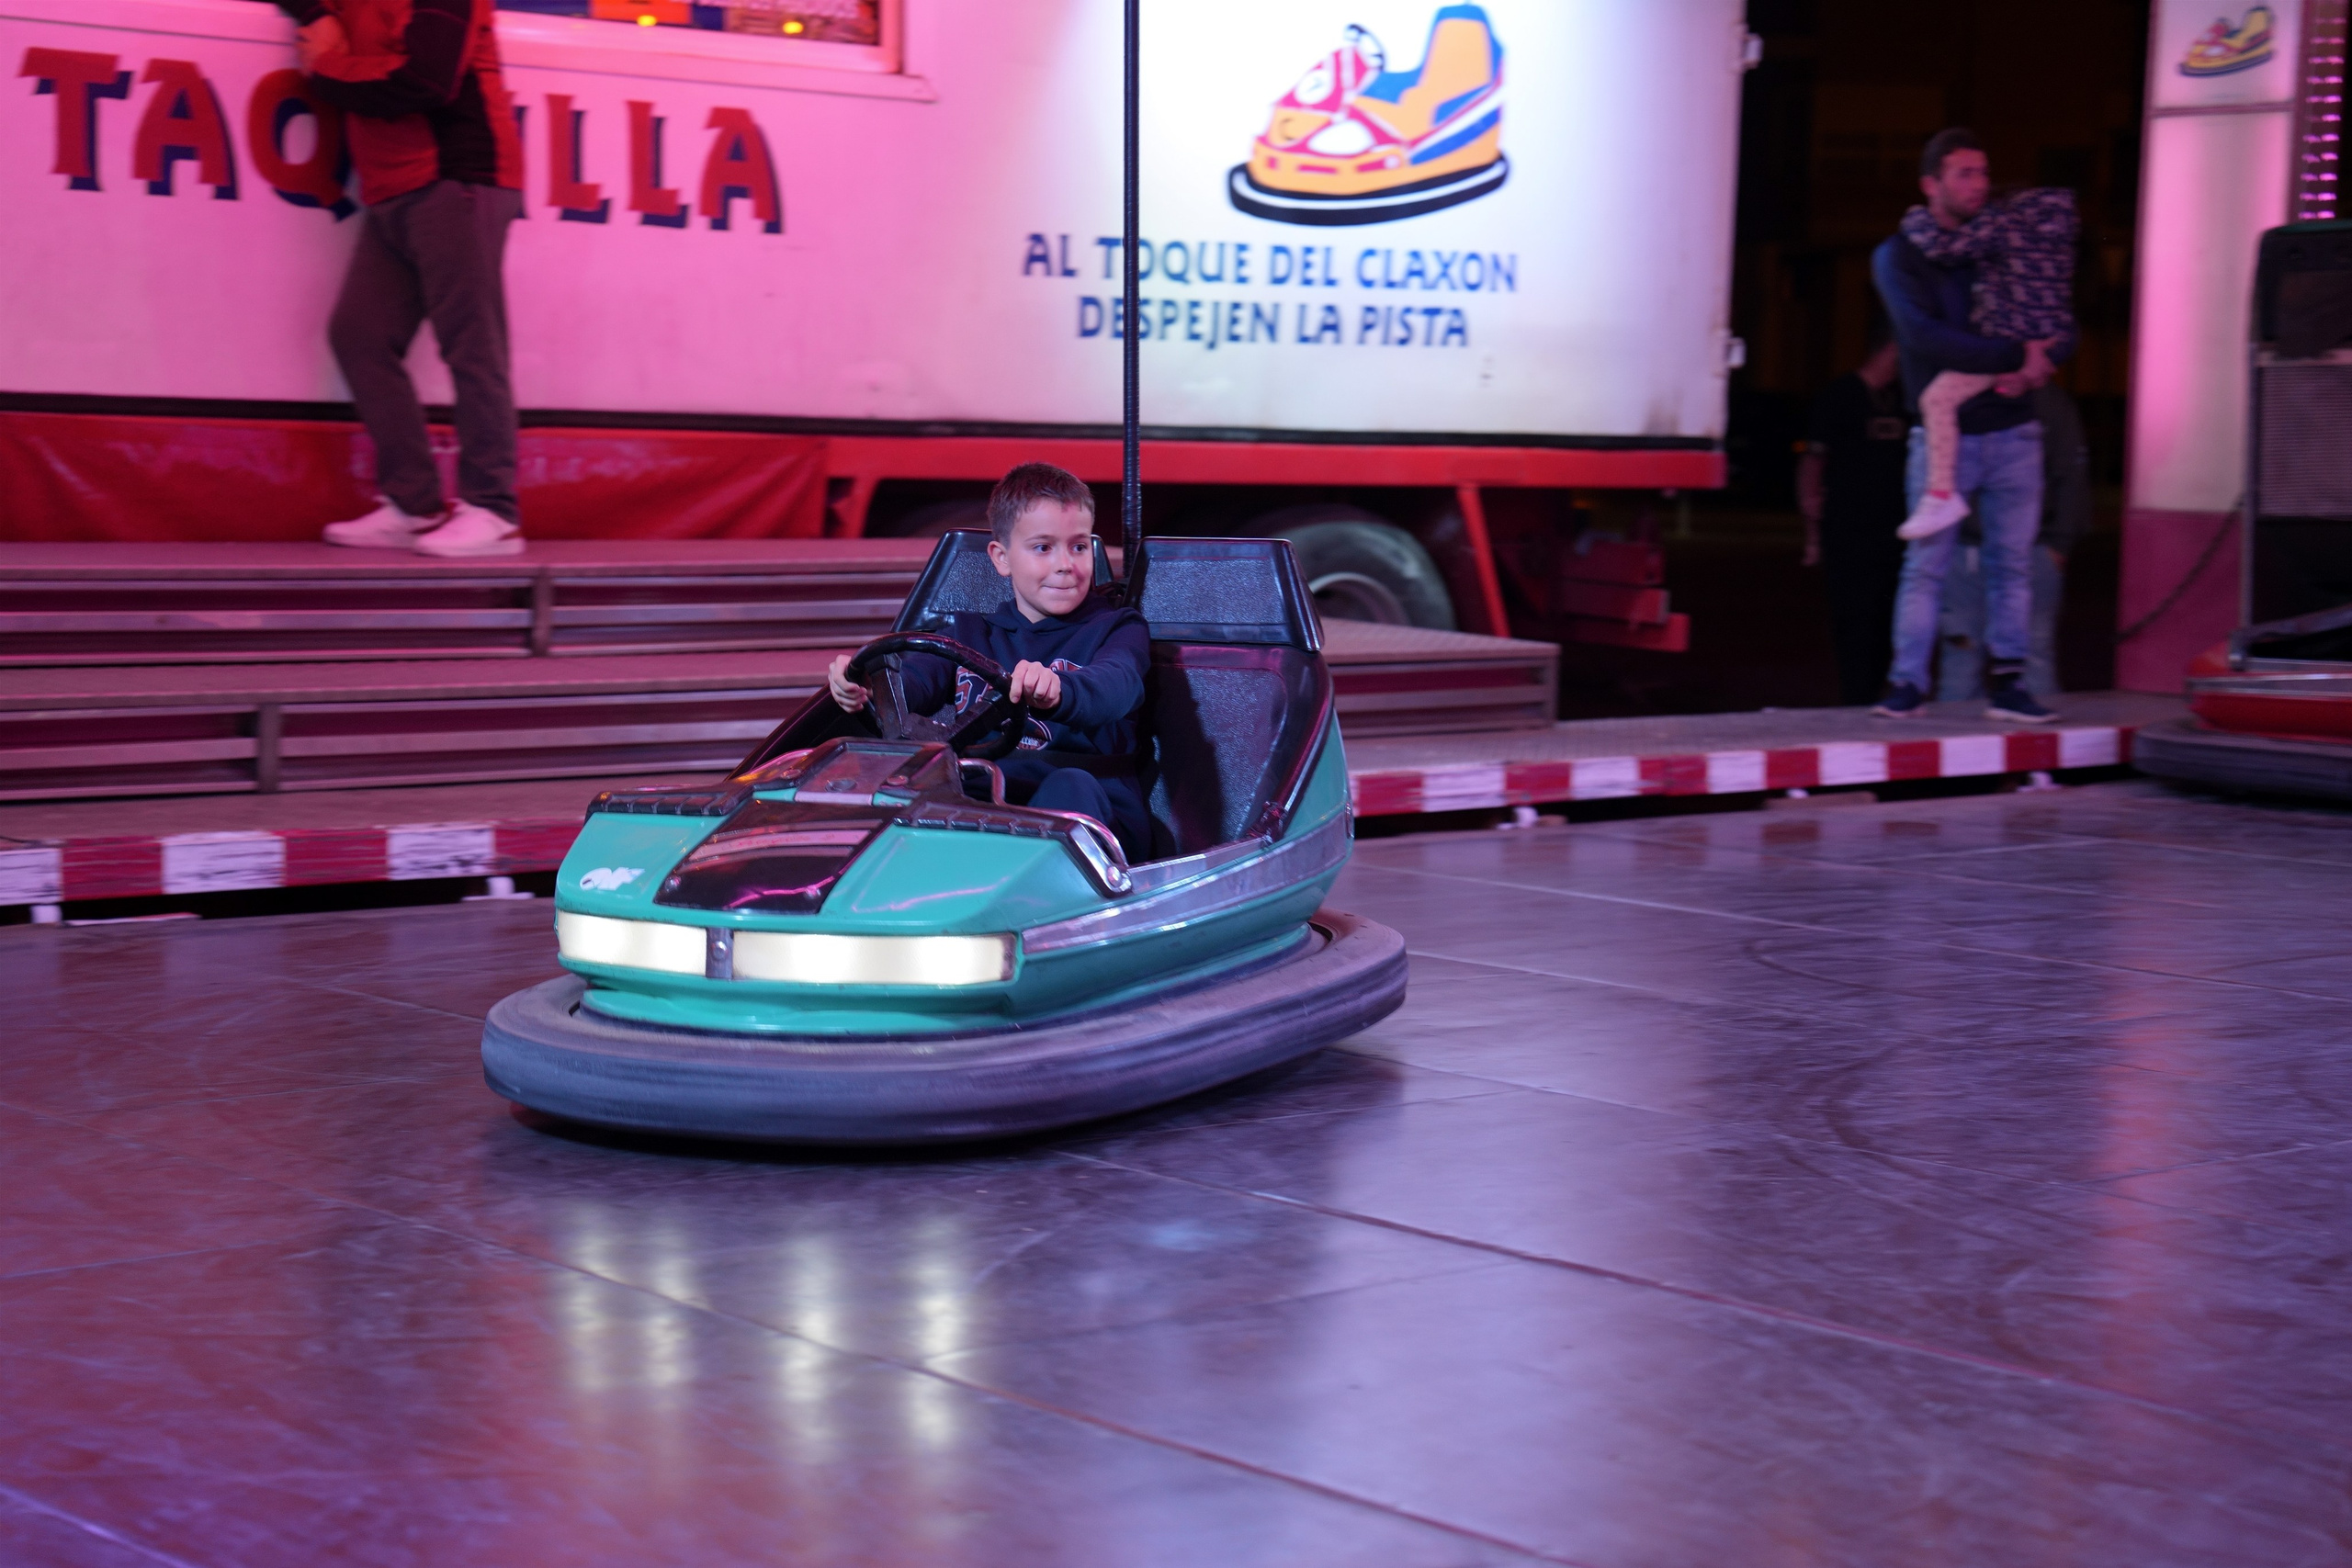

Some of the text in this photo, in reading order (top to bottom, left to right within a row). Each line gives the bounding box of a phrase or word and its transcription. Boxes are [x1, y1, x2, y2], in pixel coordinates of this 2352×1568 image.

[18, 47, 784, 233] TAQLLA
[1023, 233, 1518, 292] AL TOQUE DEL CLAXON
[1078, 297, 1468, 349] DESPEJEN LA PISTA
